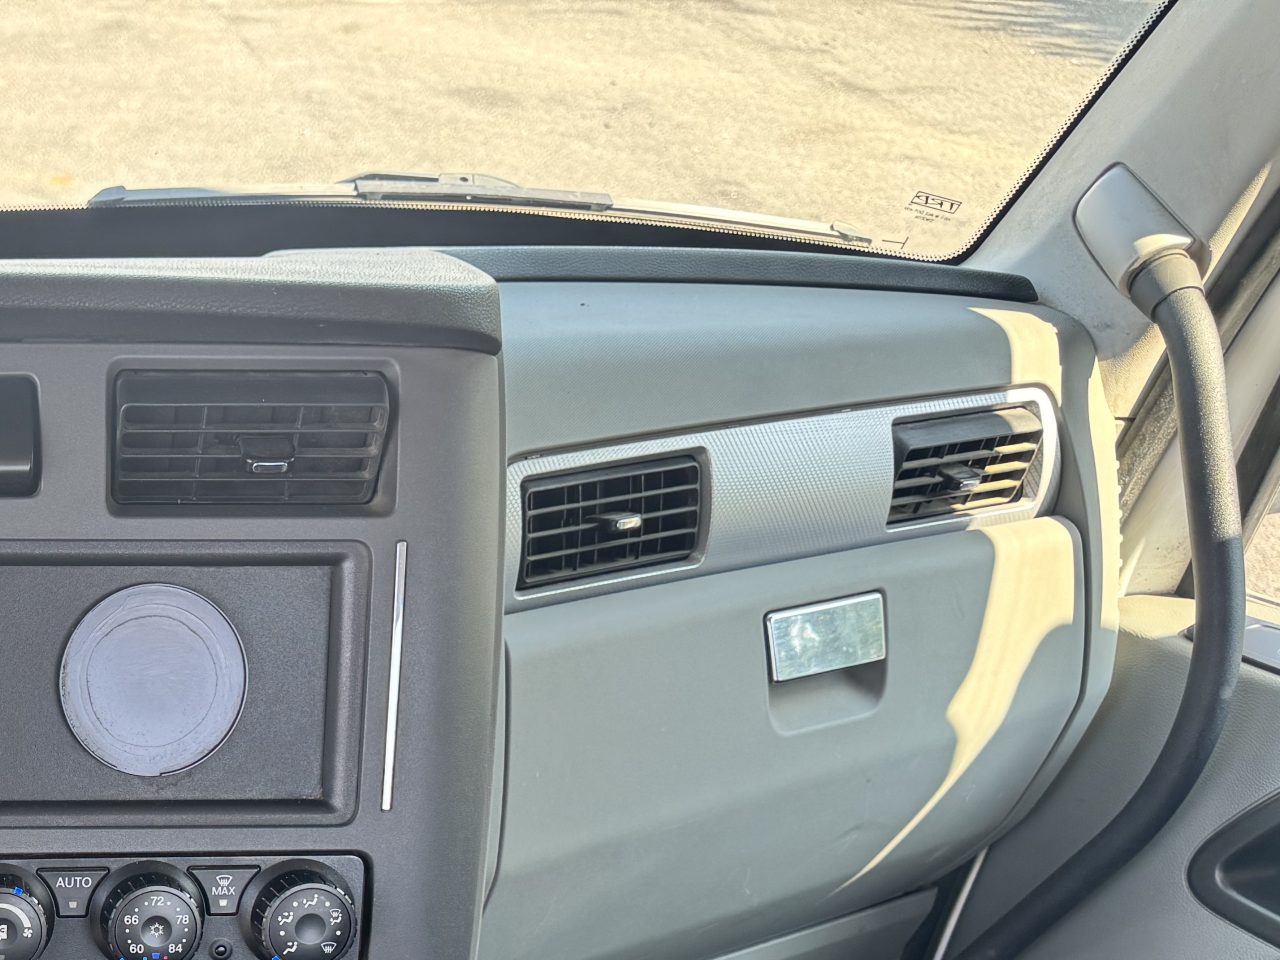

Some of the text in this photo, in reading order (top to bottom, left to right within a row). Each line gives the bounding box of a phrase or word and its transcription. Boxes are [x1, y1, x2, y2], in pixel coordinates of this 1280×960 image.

[55, 876, 92, 888] AUTO
[211, 886, 236, 896] MAX
[150, 896, 165, 907] 72
[124, 915, 139, 925] 66
[176, 915, 190, 925] 78
[129, 943, 145, 954] 60
[168, 943, 183, 954] 84
